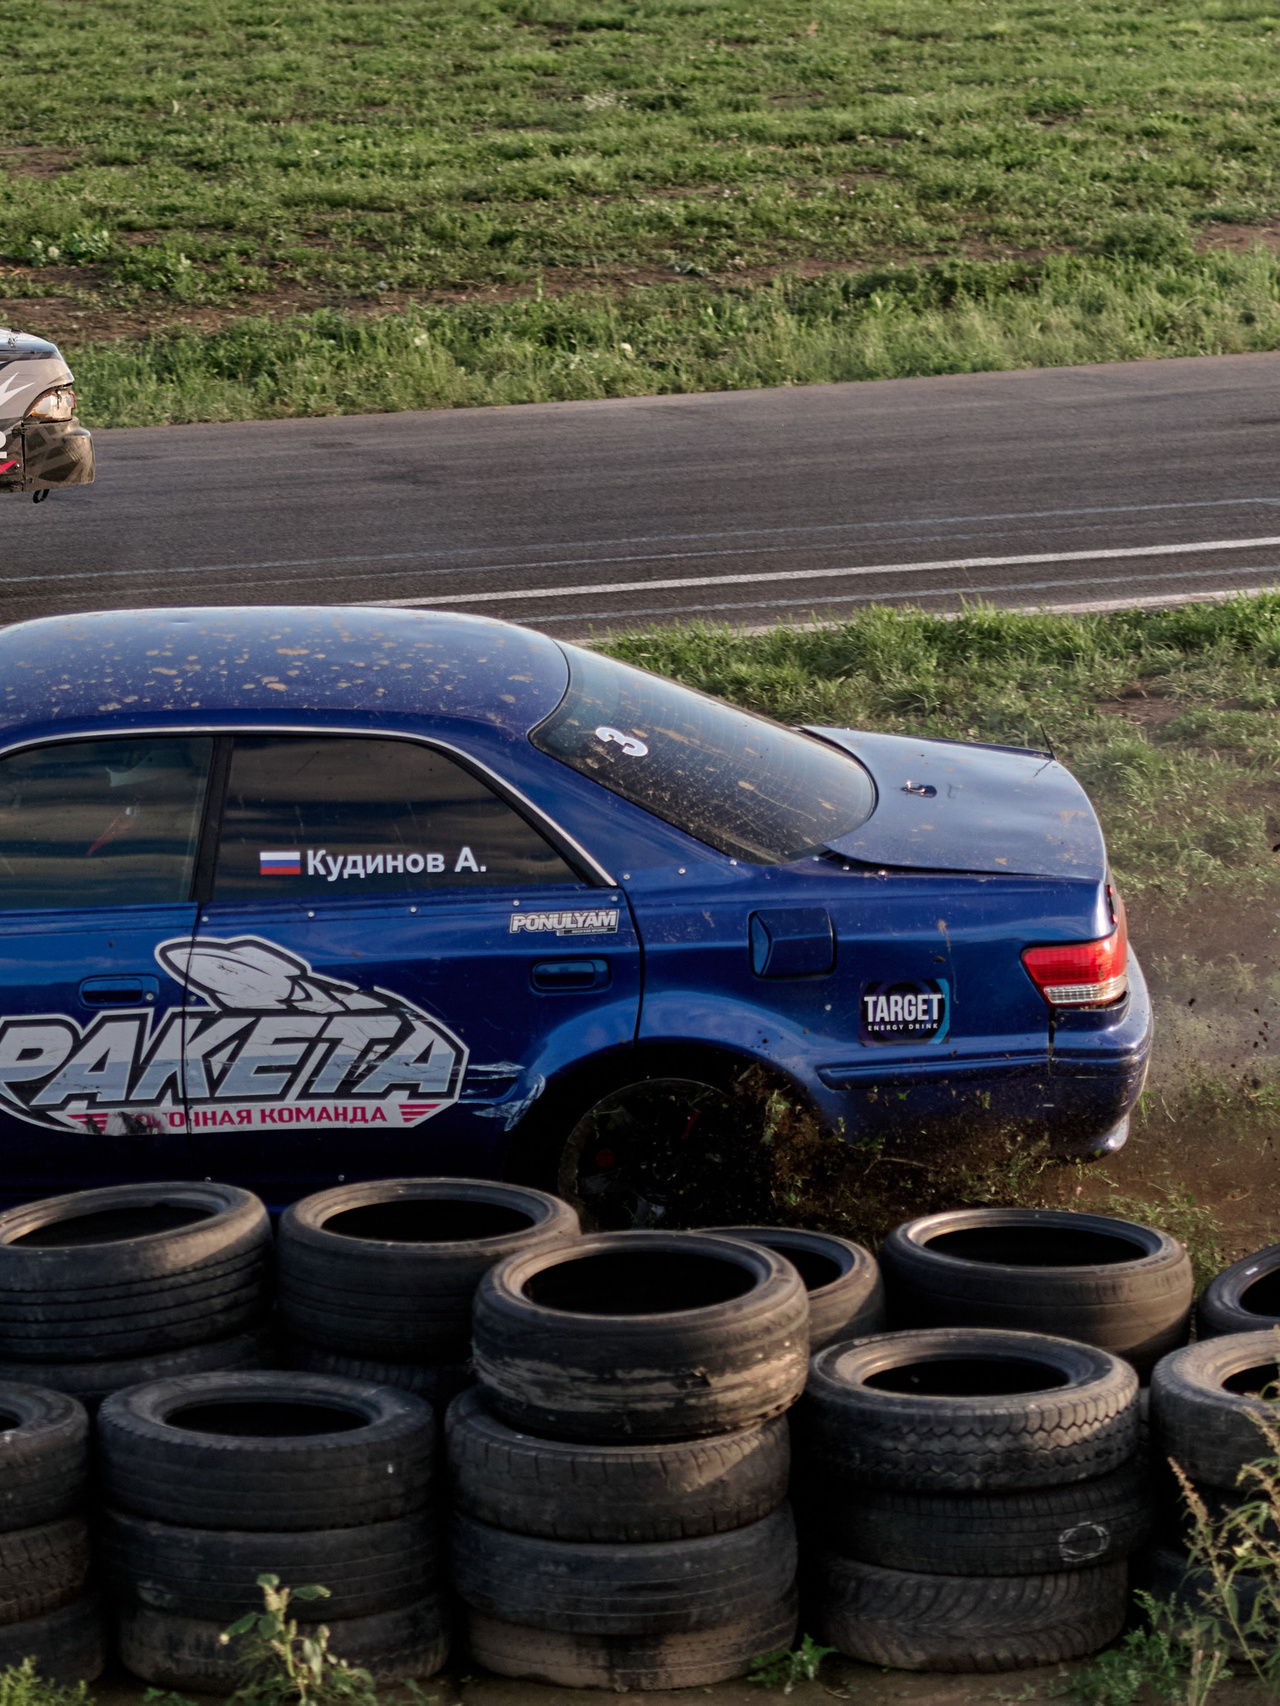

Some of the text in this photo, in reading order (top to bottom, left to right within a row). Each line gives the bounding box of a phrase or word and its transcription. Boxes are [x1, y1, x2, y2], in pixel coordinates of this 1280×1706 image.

[595, 726, 649, 757] 3
[307, 846, 487, 882] Кудинов А.
[511, 910, 617, 931] PONULYAM
[863, 993, 942, 1023] TARGET
[260, 1105, 389, 1125] КОМАНДА
